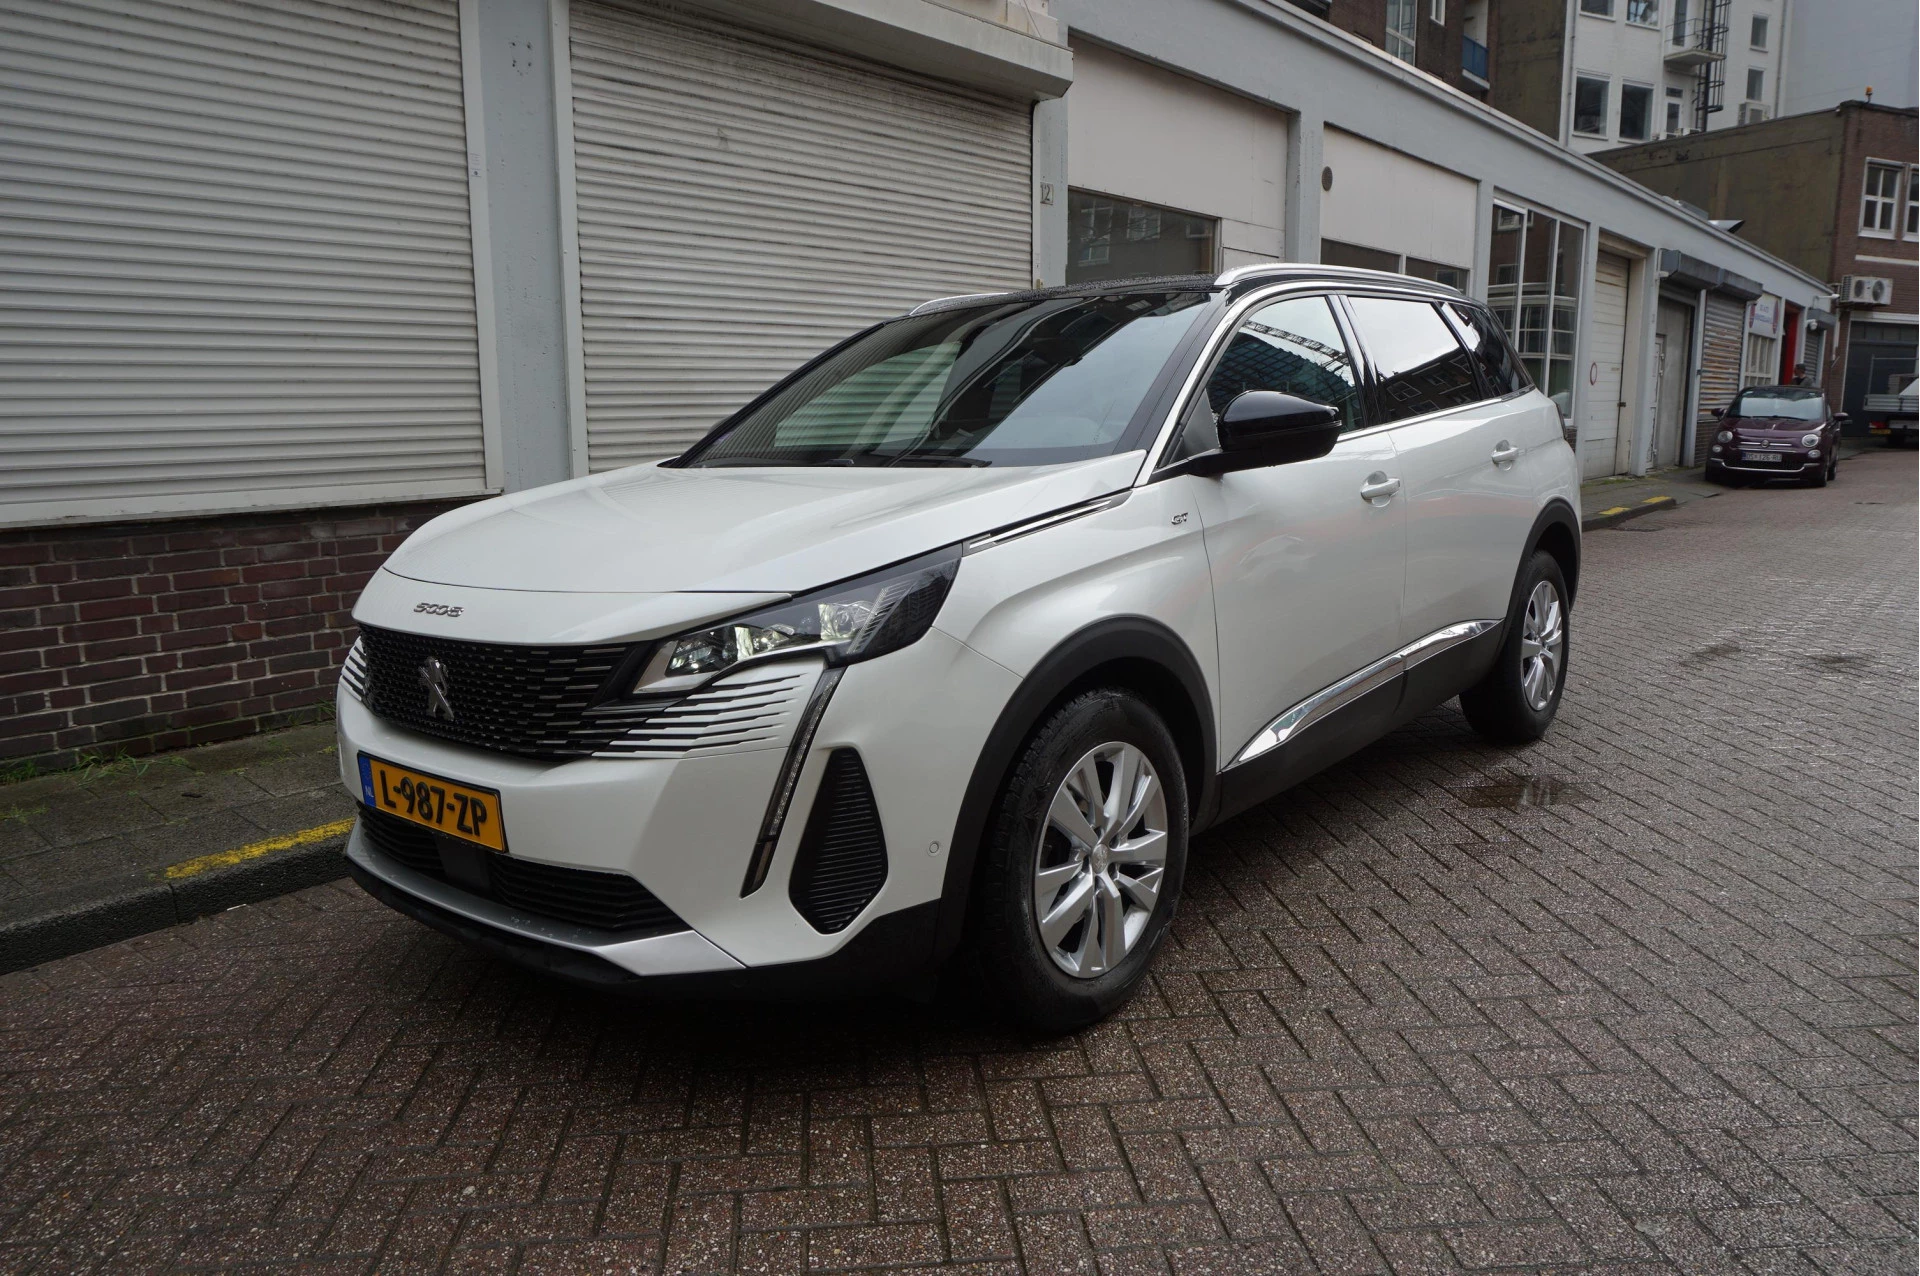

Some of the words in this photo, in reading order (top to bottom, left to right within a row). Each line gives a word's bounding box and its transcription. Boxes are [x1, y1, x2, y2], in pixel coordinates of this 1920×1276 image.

[1040, 183, 1051, 202] 12
[1171, 512, 1188, 525] GT
[413, 602, 464, 618] 5008
[365, 786, 375, 798] NL
[380, 769, 487, 837] L-987-ZP
